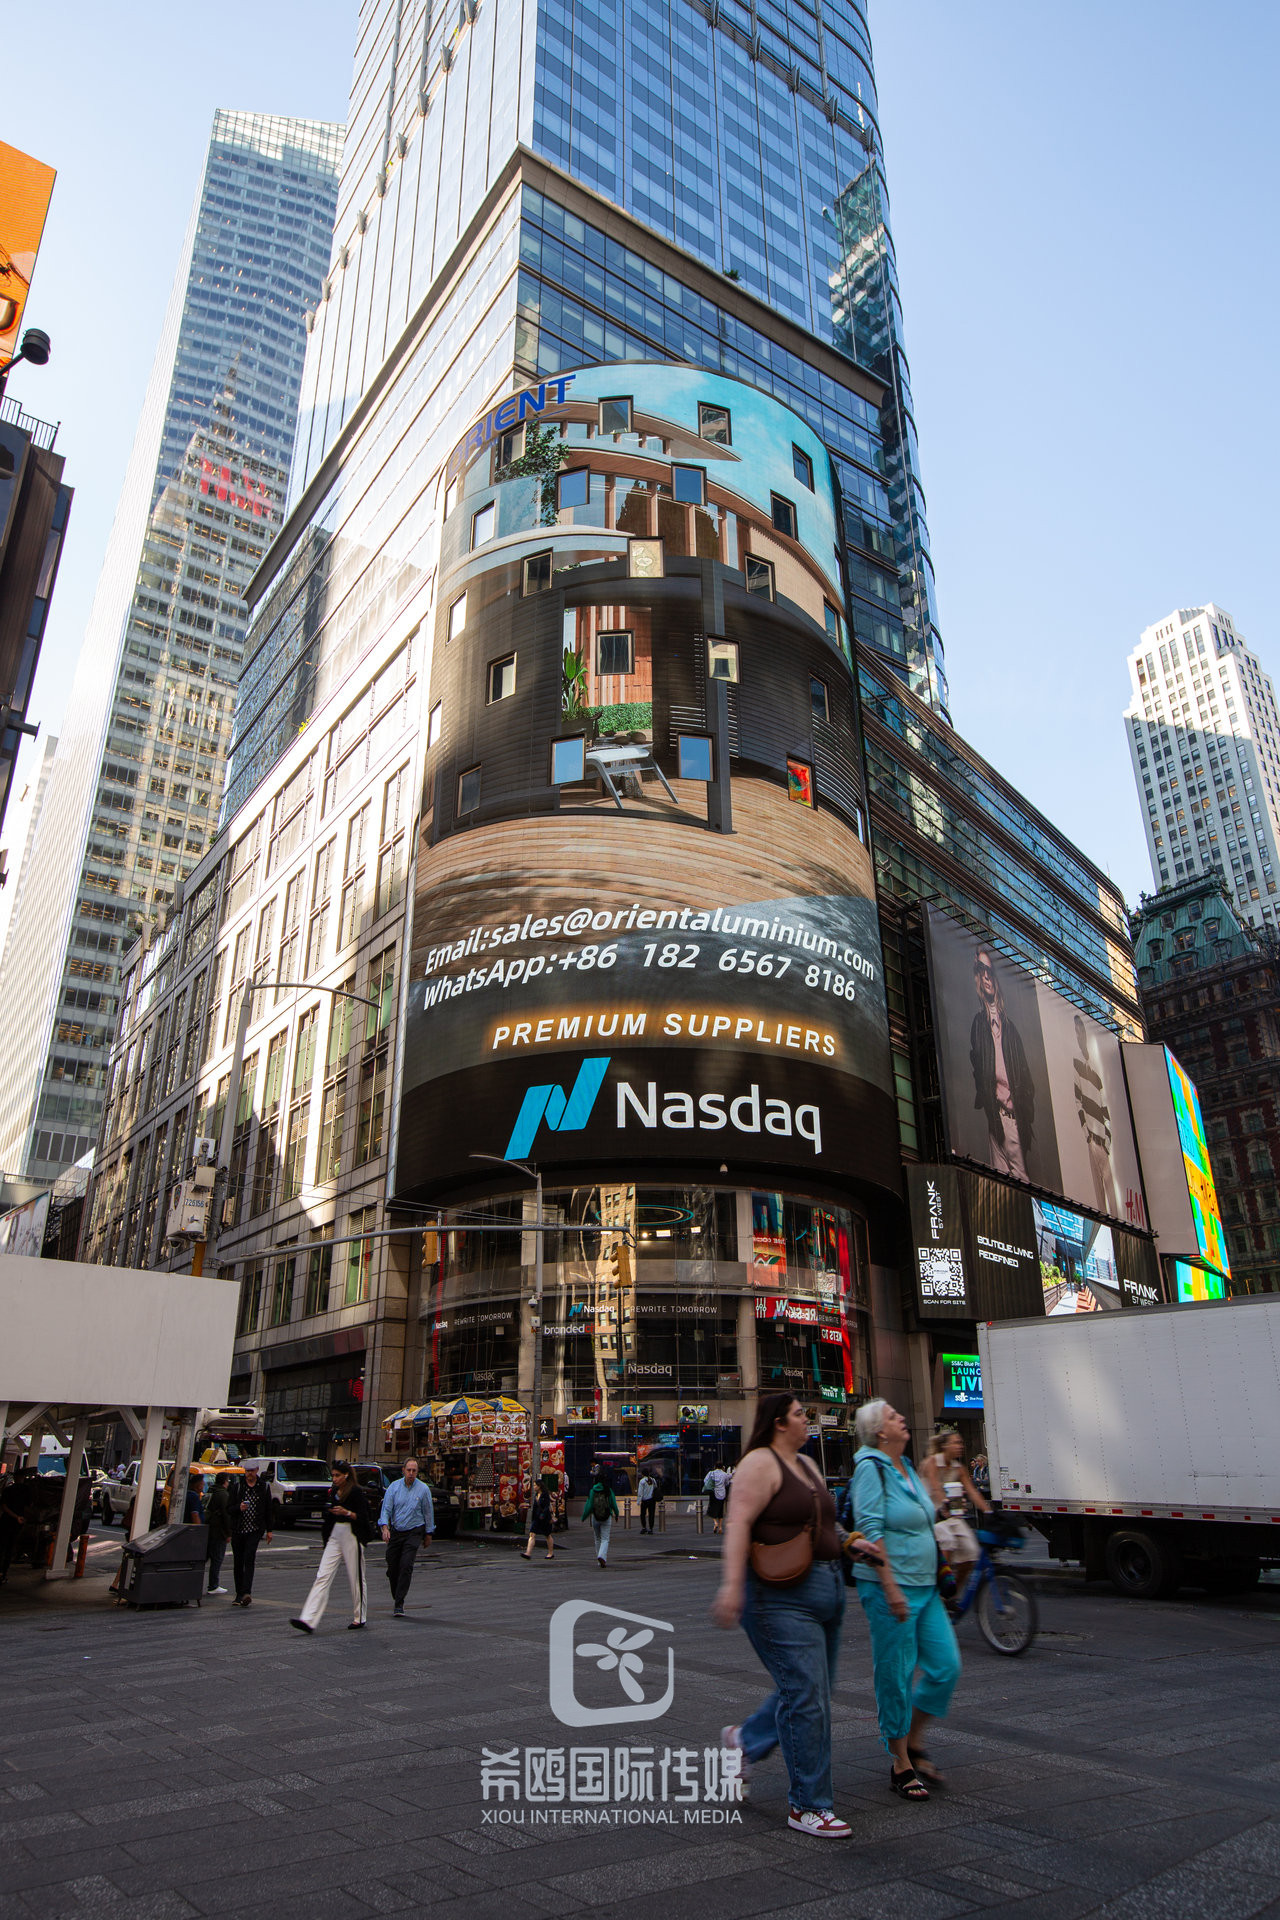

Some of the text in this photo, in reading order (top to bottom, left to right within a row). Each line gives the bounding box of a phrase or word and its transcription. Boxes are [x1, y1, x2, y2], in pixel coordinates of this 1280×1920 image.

[447, 374, 576, 478] ORIENT
[425, 903, 875, 981] Email:sales@orientaluminium.com
[423, 943, 857, 1010] WhatsApp:+86 182 6567 8186
[492, 1013, 836, 1056] PREMIUM SUPPLIERS
[616, 1081, 823, 1155] Nasdaq
[926, 1180, 940, 1240] FRANK
[977, 1235, 1034, 1260] BOUTIQUE LIVING
[979, 1249, 1019, 1268] REDEFINED
[1123, 1279, 1159, 1301] FRANK
[1132, 1295, 1140, 1304] 57
[583, 1304, 718, 1314] Nasdaq REWRITE TOMORROW
[627, 1362, 673, 1376] Nasdaq
